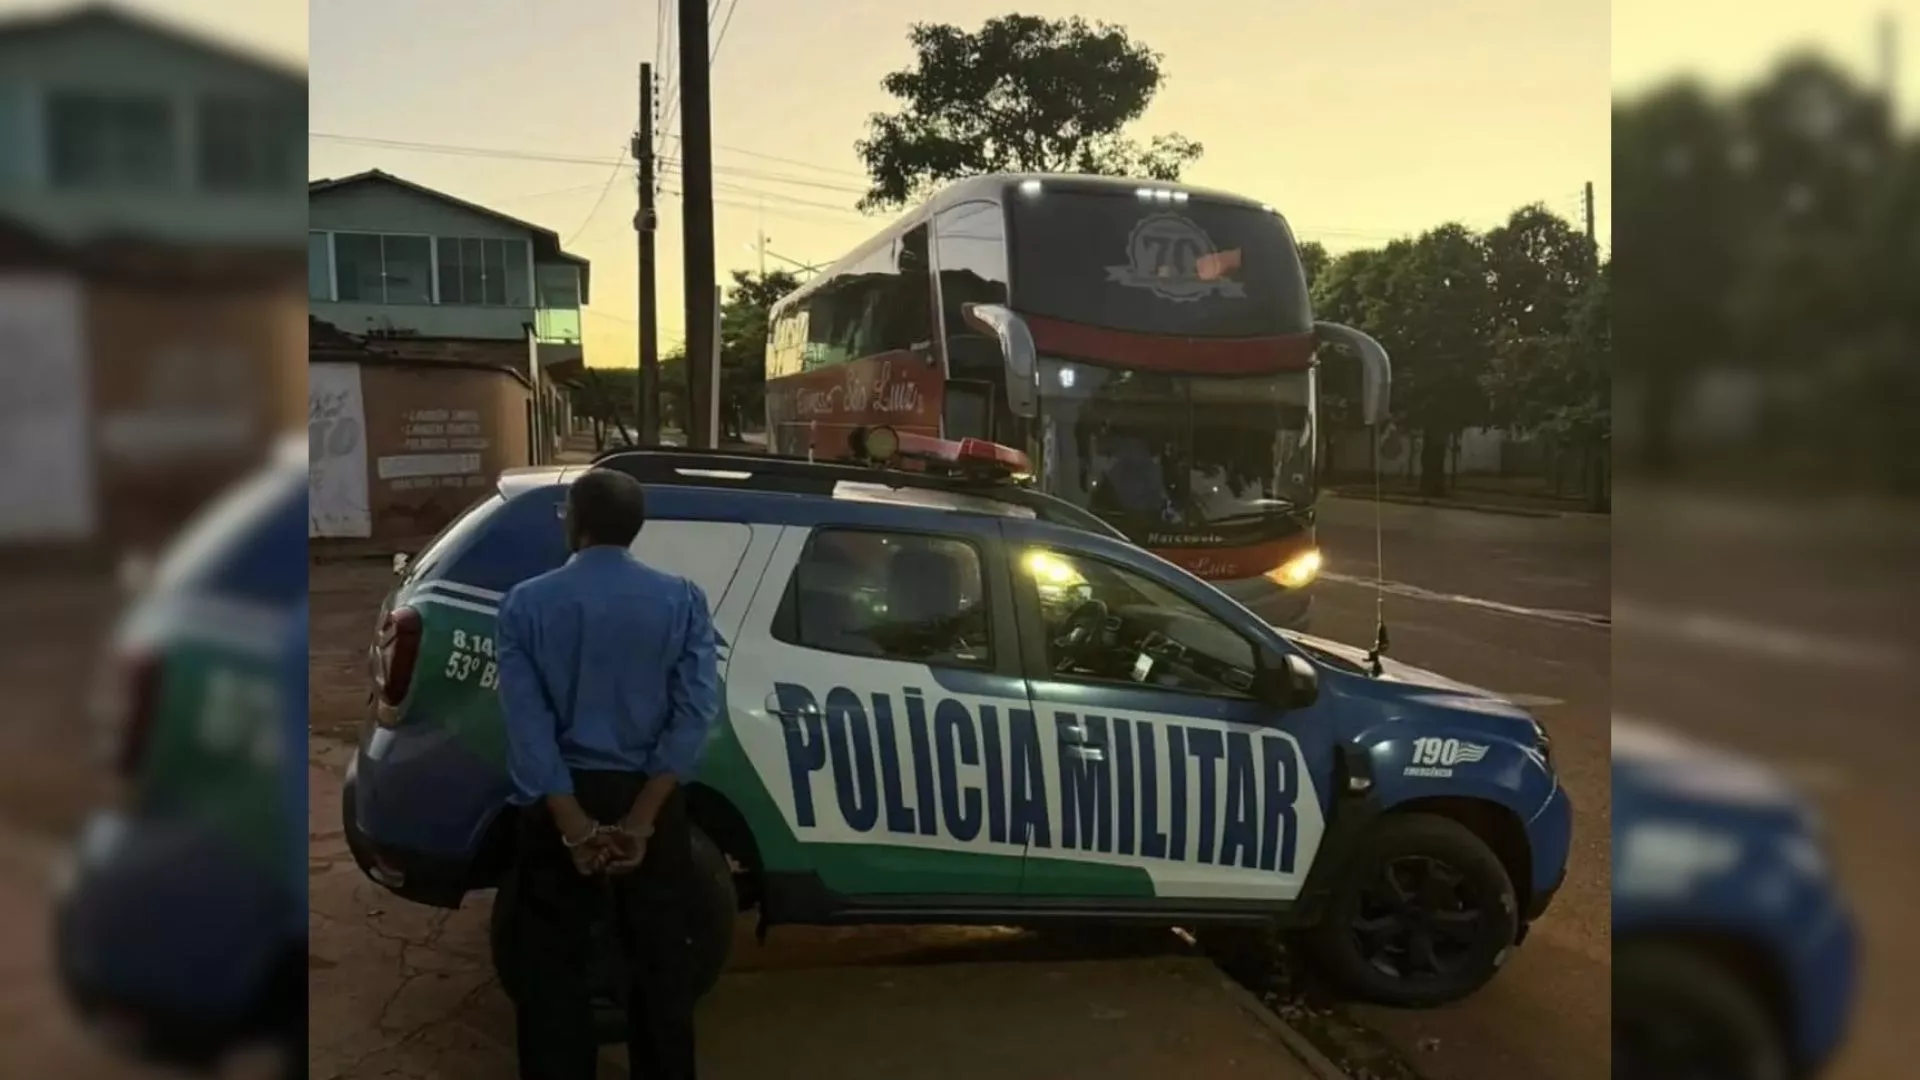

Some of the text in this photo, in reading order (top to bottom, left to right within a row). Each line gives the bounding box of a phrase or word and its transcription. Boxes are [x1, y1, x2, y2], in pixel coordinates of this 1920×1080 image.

[872, 360, 918, 413] Luiz
[774, 681, 1301, 874] POLÍCIA MILITAR
[1411, 736, 1460, 766] 190
